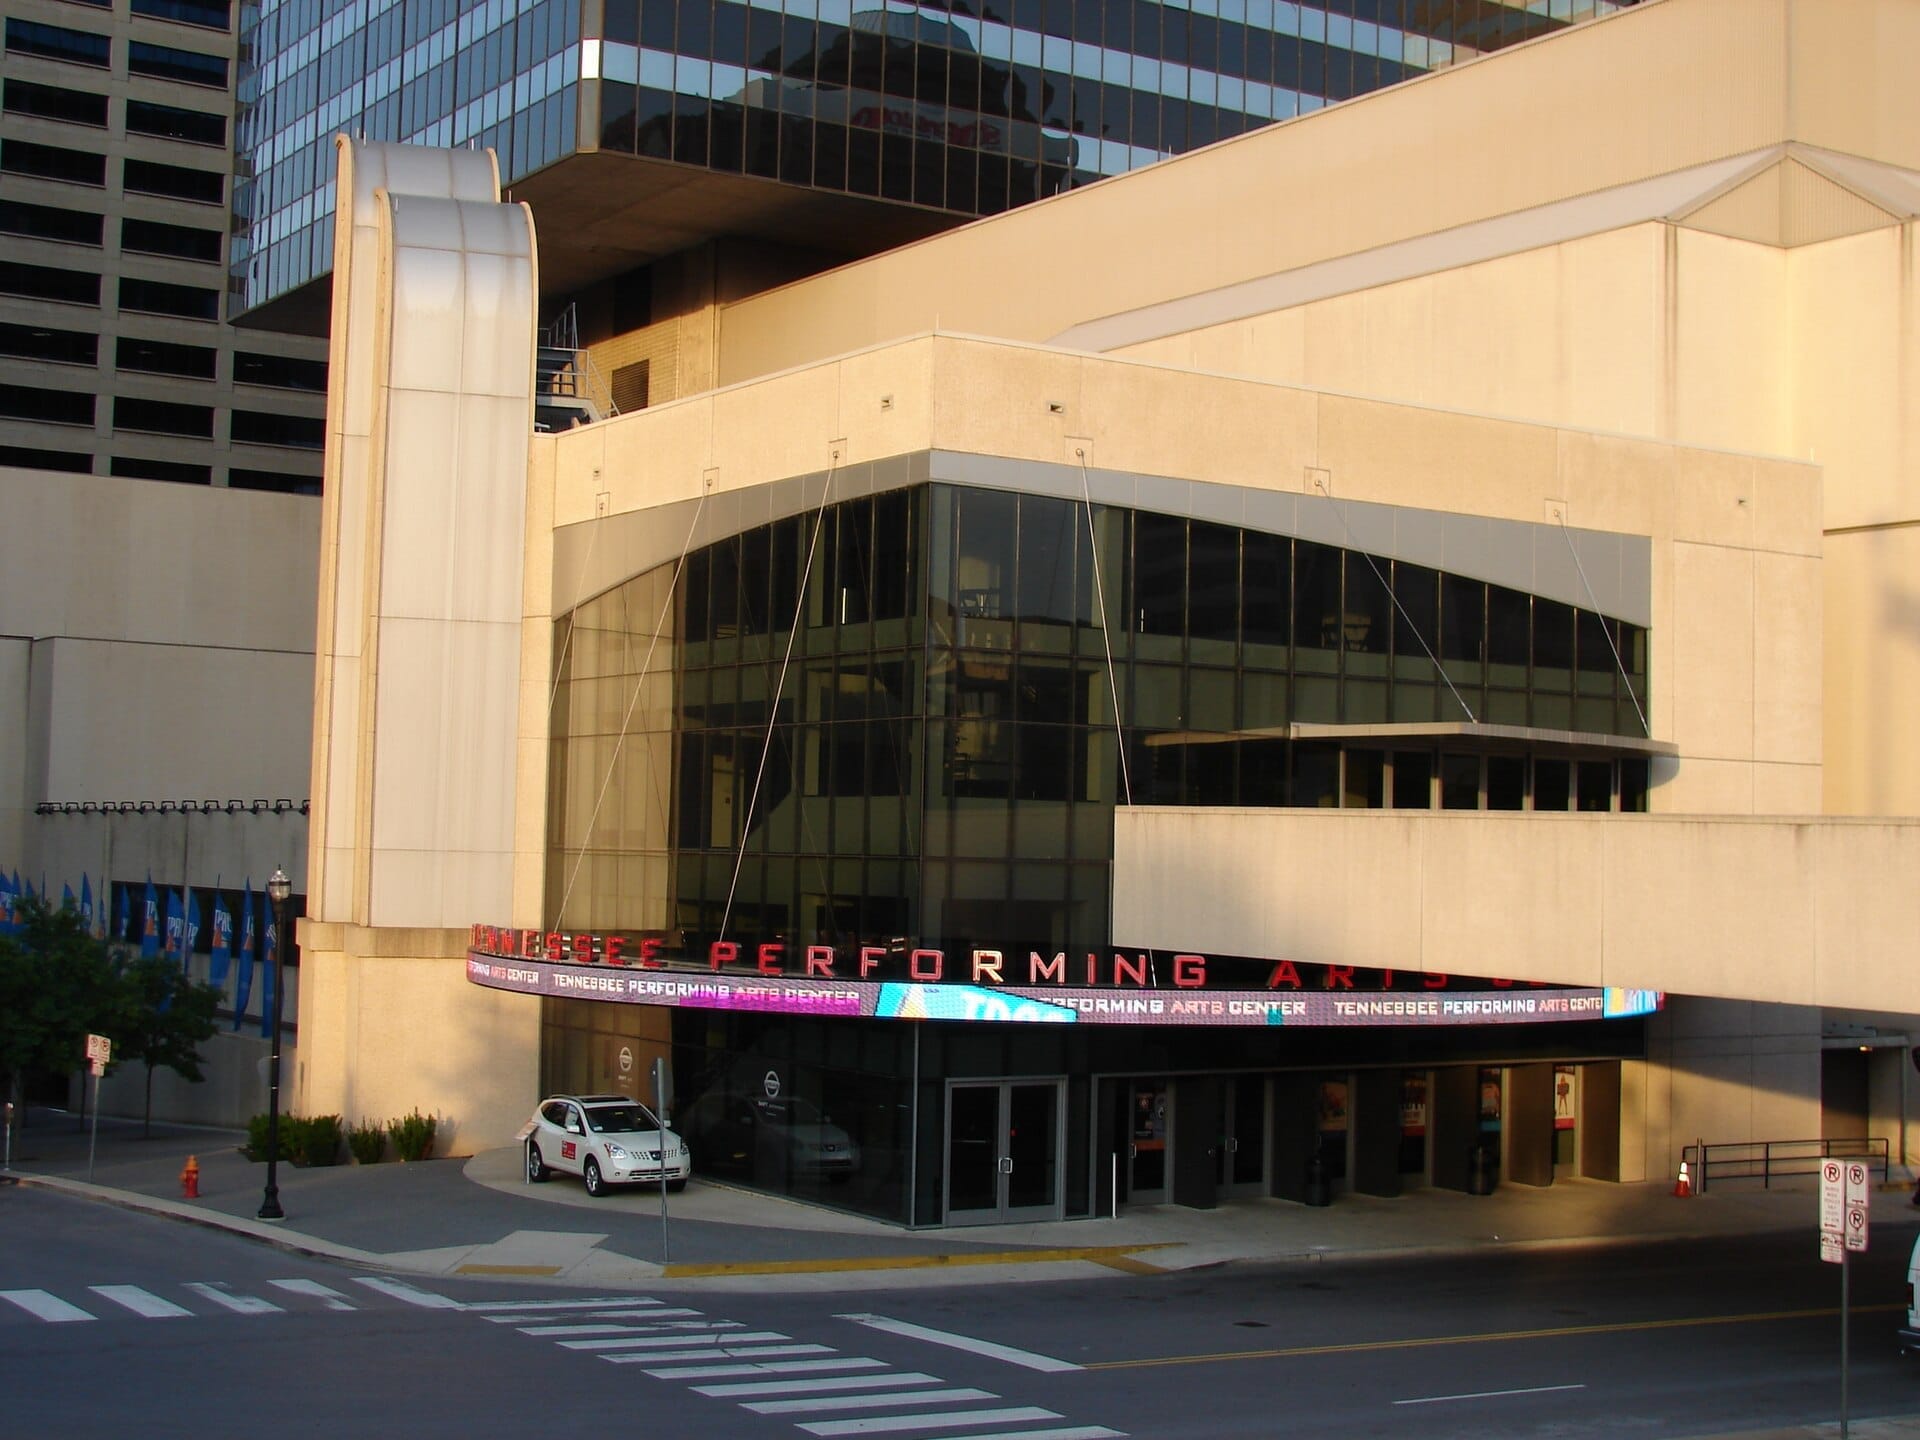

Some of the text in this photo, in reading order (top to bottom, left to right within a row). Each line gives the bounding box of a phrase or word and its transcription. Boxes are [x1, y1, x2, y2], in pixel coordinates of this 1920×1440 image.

[167, 916, 184, 938] TPA
[709, 941, 1207, 987] PERFORMING
[507, 968, 539, 985] CENTER
[553, 973, 624, 993] TENNESSEE
[629, 979, 730, 998] PERFORMING
[1170, 1000, 1225, 1015] ARTS
[1228, 1000, 1306, 1016] CENTER
[1334, 1000, 1438, 1016] TENNESSEE
[1443, 998, 1536, 1015] PERFORMING
[1539, 998, 1569, 1013] ARTS
